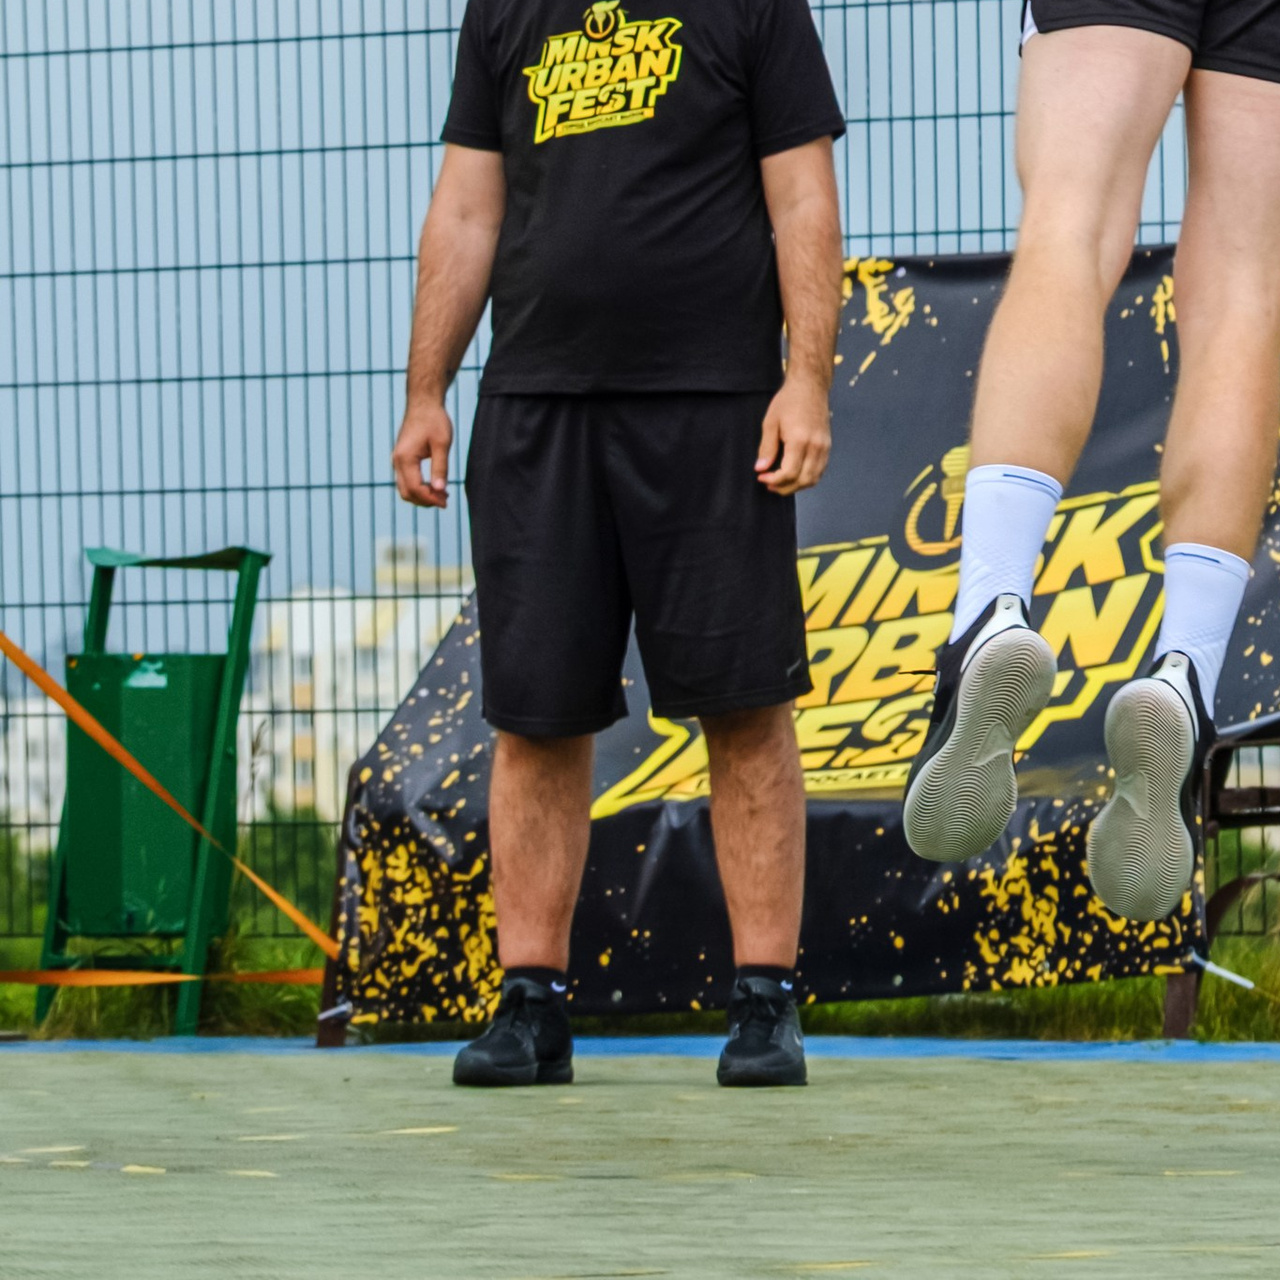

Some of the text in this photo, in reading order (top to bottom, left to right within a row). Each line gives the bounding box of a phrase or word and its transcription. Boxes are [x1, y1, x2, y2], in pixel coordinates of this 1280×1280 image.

[545, 23, 669, 67] MINSK
[534, 48, 672, 97] URBAN
[544, 76, 656, 132] FEST
[797, 493, 1161, 630] MINK
